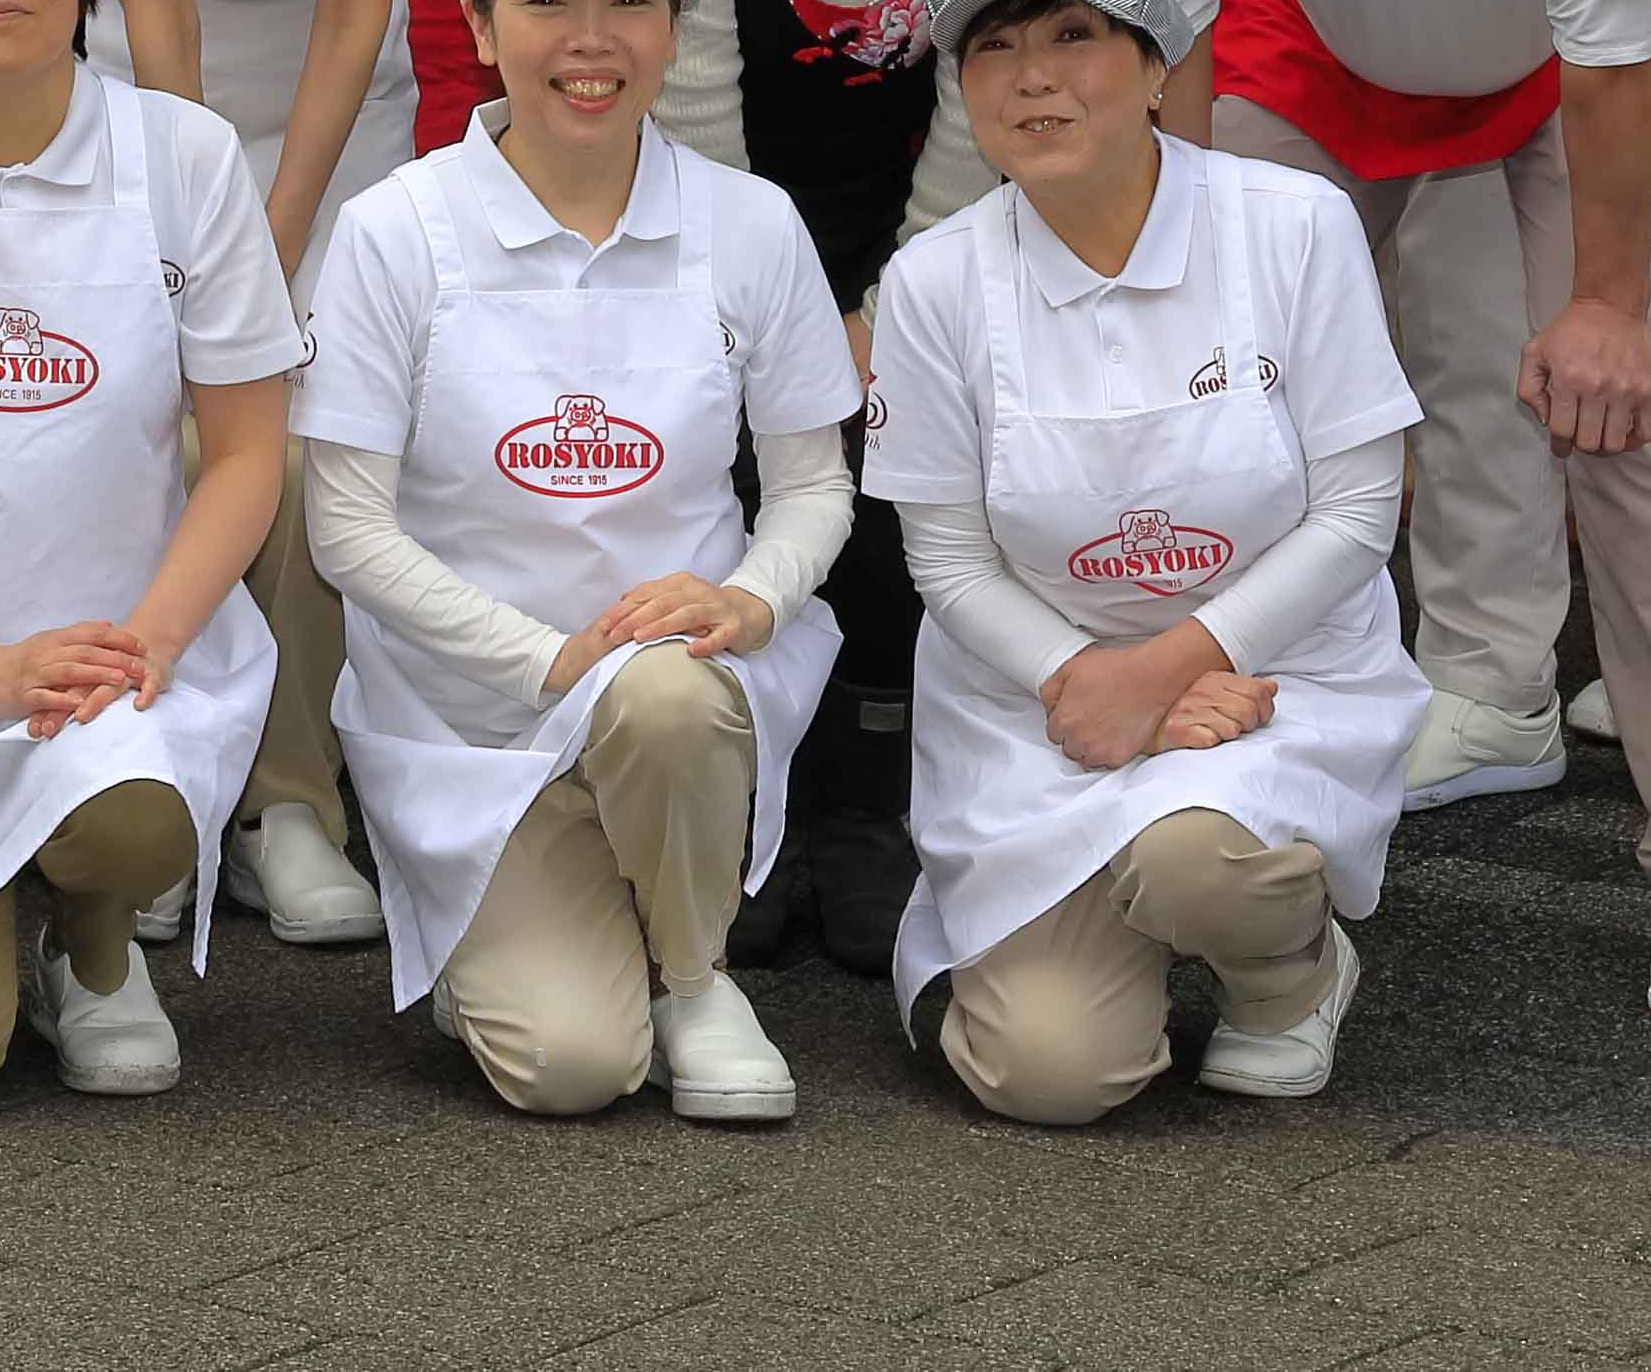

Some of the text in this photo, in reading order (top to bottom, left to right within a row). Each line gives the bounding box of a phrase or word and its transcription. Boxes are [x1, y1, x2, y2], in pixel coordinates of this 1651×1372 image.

[22, 388, 41, 401] 1915
[507, 442, 652, 469] ROSYOKI
[550, 474, 608, 486] SINCE 1915
[1080, 543, 1223, 578] ROSYOKI
